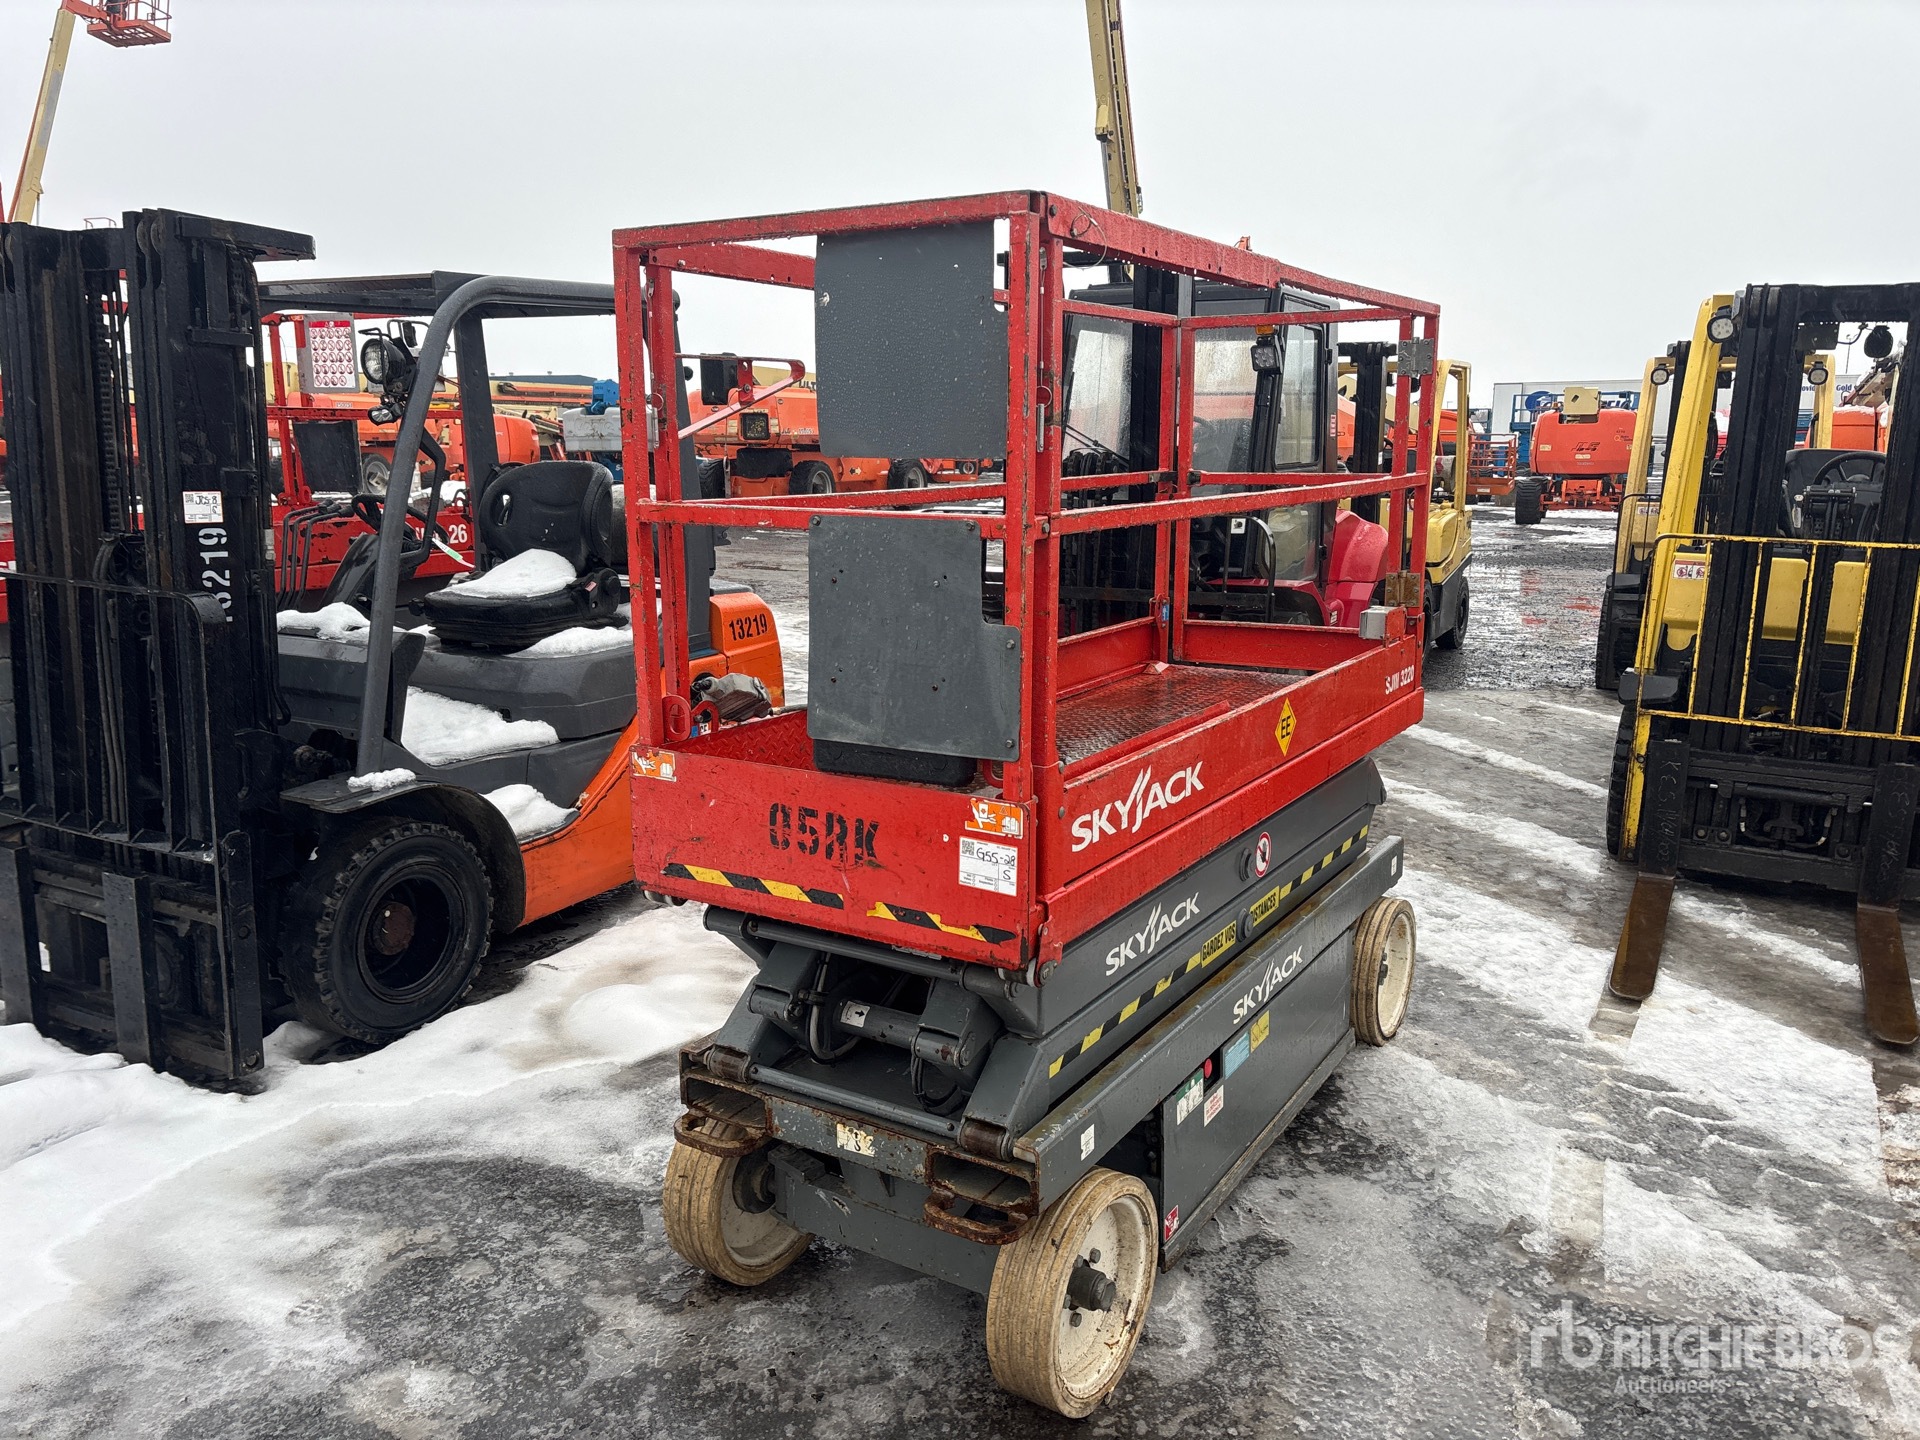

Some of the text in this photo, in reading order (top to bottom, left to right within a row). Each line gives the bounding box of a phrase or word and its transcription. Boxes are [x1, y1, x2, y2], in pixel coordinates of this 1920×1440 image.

[1836, 383, 1852, 391] Gold
[729, 613, 768, 641] 13219
[1400, 664, 1415, 687] 3220
[1281, 714, 1291, 740] EE
[1071, 761, 1205, 853] SKYJACK
[769, 803, 880, 866] 05RK
[1105, 892, 1200, 977] SKYJACK
[1202, 931, 1225, 962] GARDEZ
[1224, 923, 1236, 944] VOS
[1233, 945, 1304, 1025] SKYJACK
